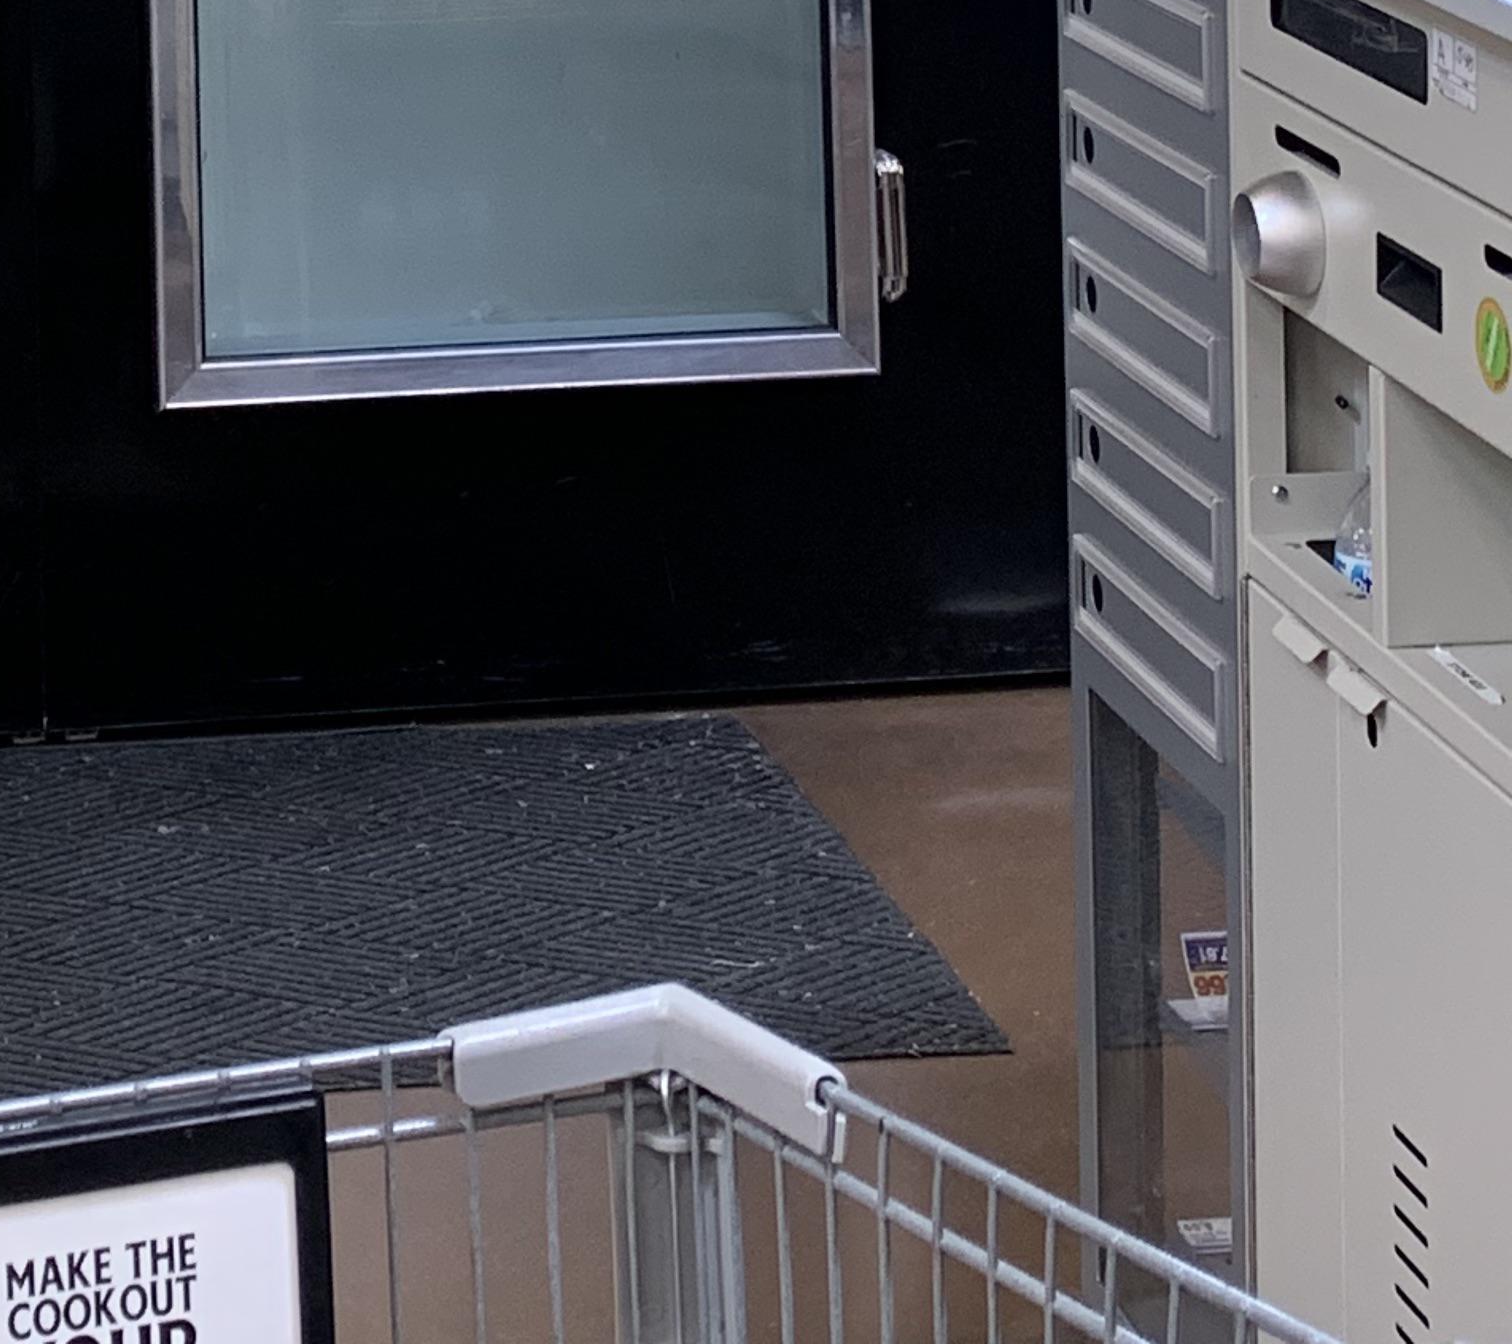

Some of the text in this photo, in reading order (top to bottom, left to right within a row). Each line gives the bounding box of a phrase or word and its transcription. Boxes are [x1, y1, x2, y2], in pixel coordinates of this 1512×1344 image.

[6, 1232, 198, 1302] MAKE THE
[7, 1274, 198, 1341] COOKOUT
